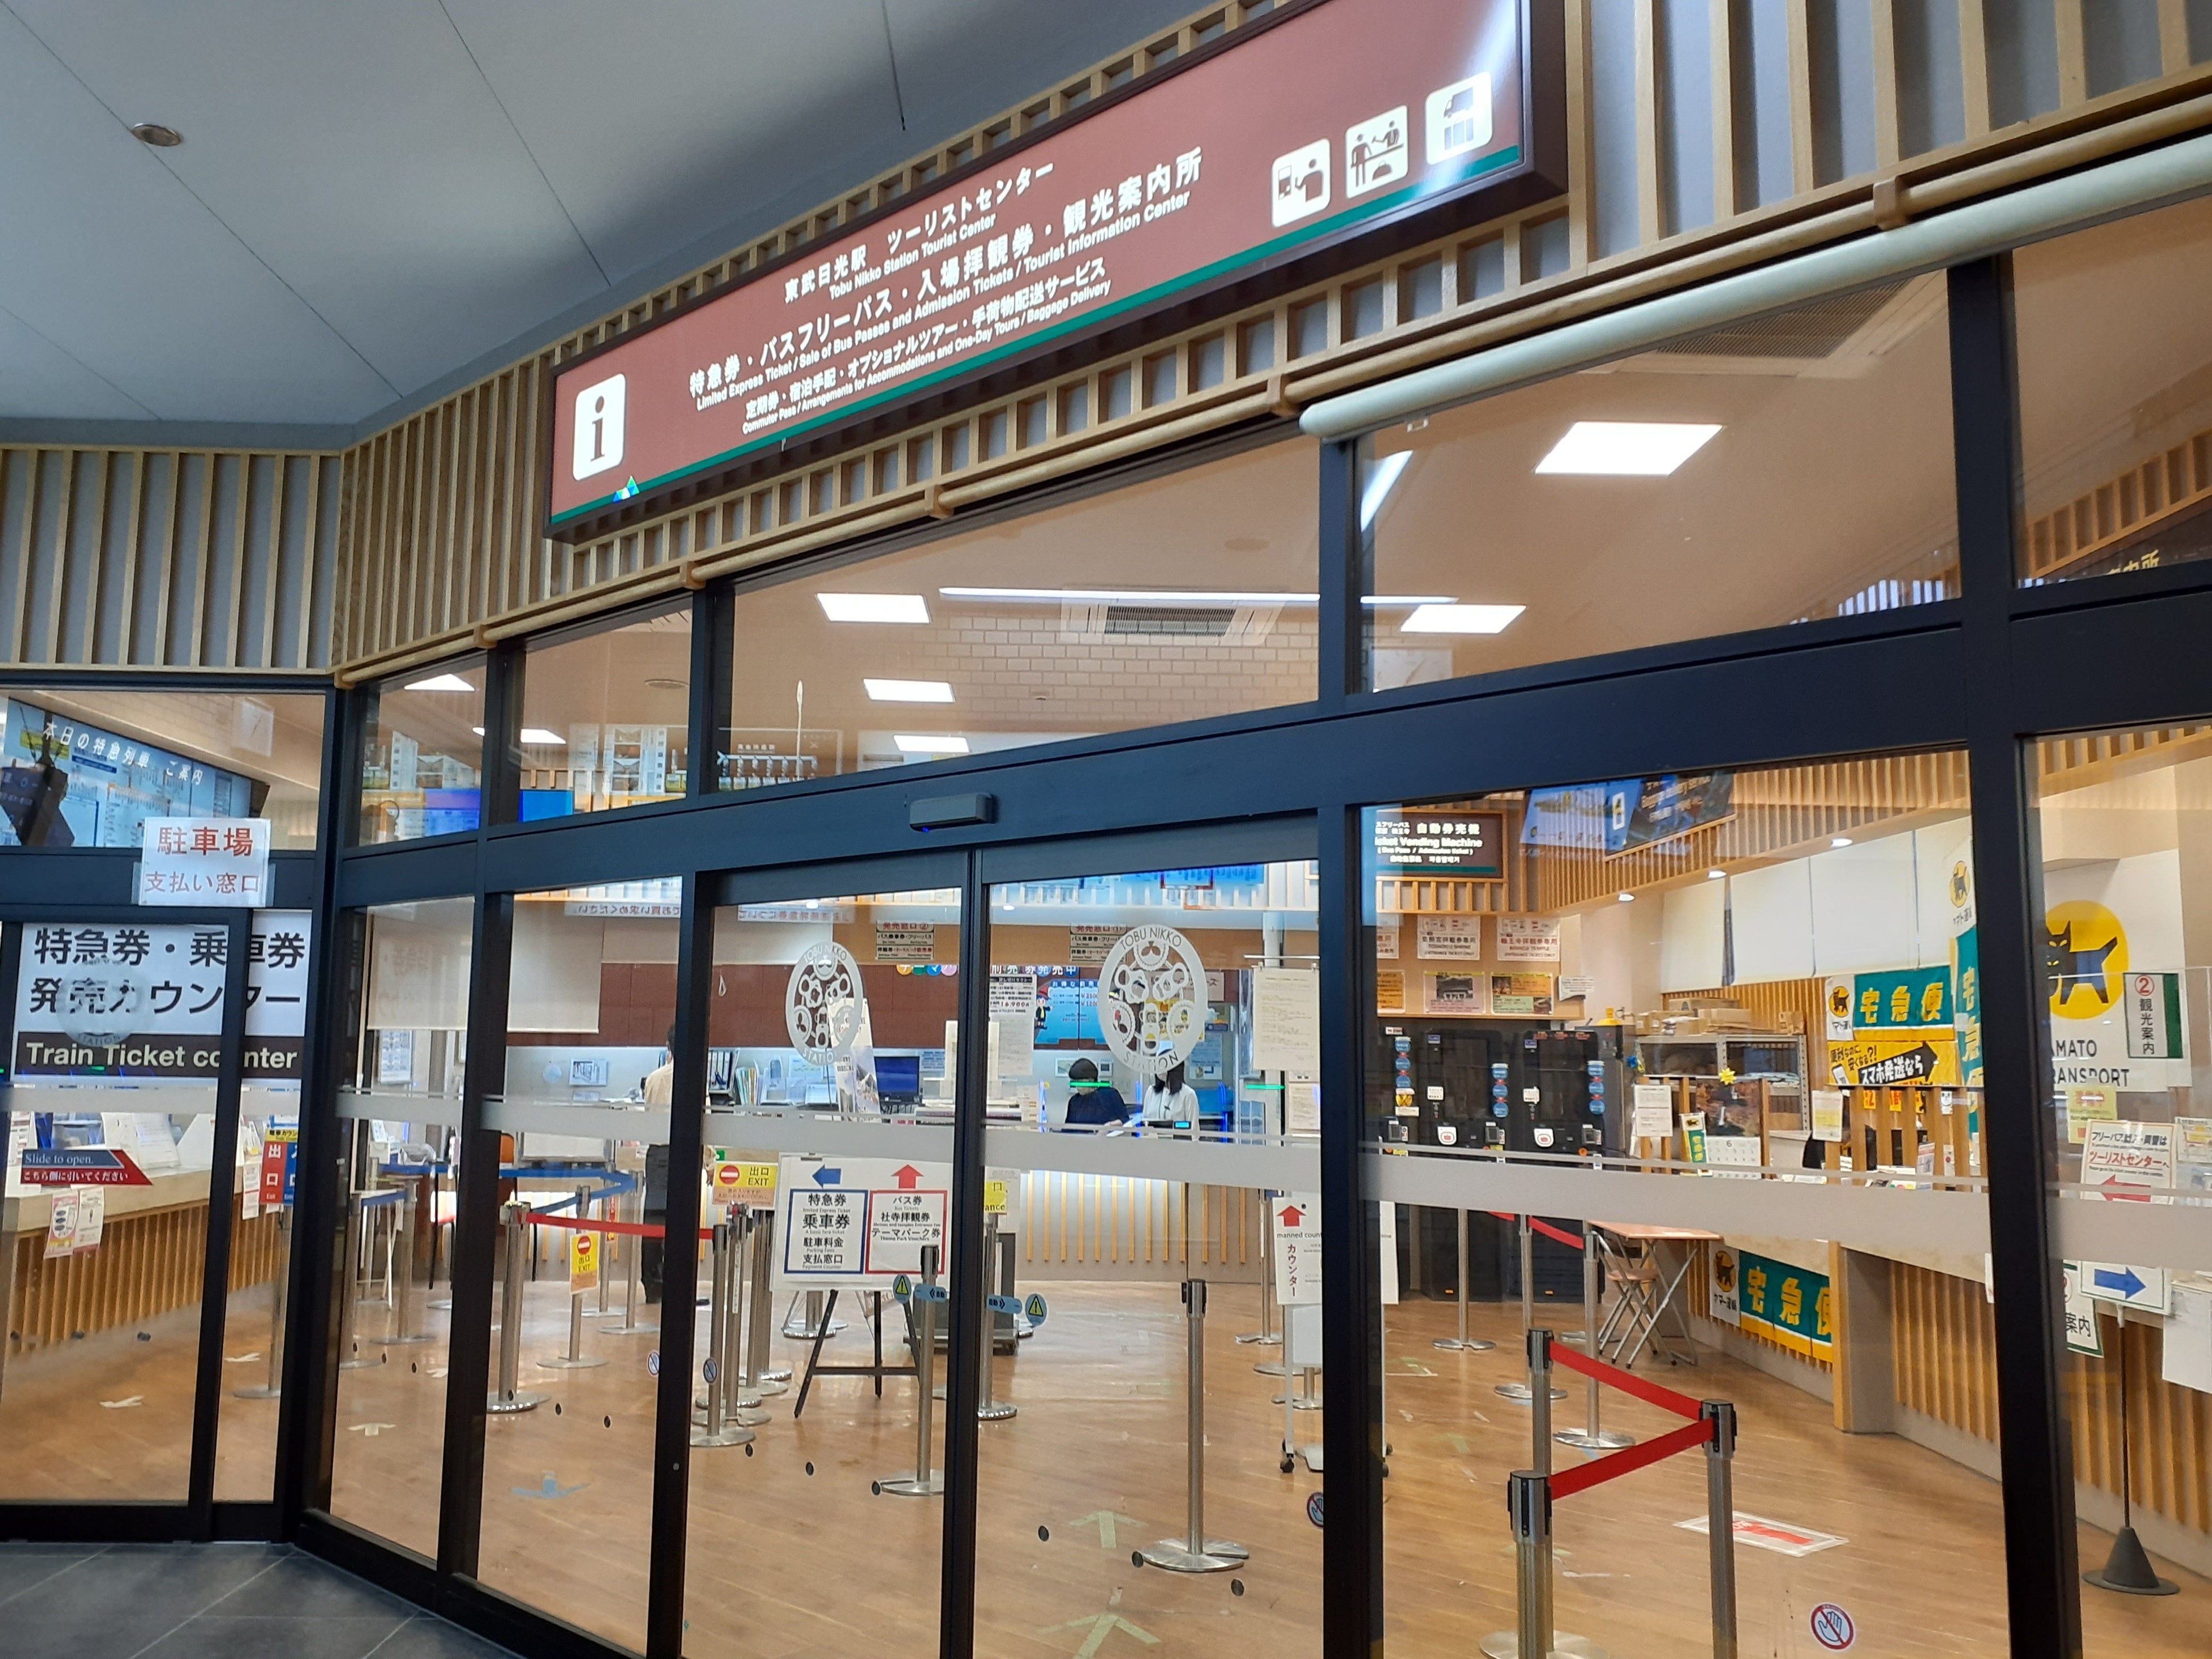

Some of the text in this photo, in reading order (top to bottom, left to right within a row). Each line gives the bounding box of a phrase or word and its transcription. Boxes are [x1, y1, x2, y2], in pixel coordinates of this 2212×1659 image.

[784, 162, 1054, 304] 東武日光駅 ツーリストセンター
[829, 213, 997, 300] Tobu Nikko Station Tourist Center
[696, 387, 727, 411] Limited
[729, 374, 763, 397] Express
[765, 360, 792, 382] Ticket
[799, 349, 820, 368] Sale
[822, 342, 832, 360] of
[833, 336, 852, 354] Bus
[855, 320, 890, 345] Passes
[892, 308, 912, 330] and
[914, 285, 970, 321] Admission
[973, 267, 1014, 296] Tickets
[1023, 243, 1065, 274] Tourist
[1067, 212, 1141, 256] Information
[1143, 191, 1191, 222] Center
[742, 413, 778, 435] Commuter
[779, 404, 796, 421] Pass
[801, 383, 853, 412] Arrangements
[854, 377, 866, 391] for
[867, 351, 936, 387] Accommodations
[937, 341, 953, 360] and
[955, 328, 993, 352] One-Day
[994, 316, 1020, 336] Tours
[1027, 298, 1069, 324] Baggage
[1070, 280, 1111, 307] Delivery
[157, 826, 254, 856] 駐車場
[1399, 837, 1441, 849] Vending
[1441, 838, 1483, 847] Machine
[145, 872, 260, 894] 支払い窓口
[1120, 927, 1181, 950] TOBU NIKKO
[1860, 982, 1943, 1023] 宅急便
[26, 1042, 298, 1069] Train Ticket conter
[1830, 1045, 1861, 1062] 便利なのに
[1861, 1055, 1923, 1084] スマホ発送なら
[2053, 1067, 2130, 1087] ANSPORT
[1726, 1139, 1733, 1148] 6
[25, 1154, 52, 1164] Slide
[66, 1156, 94, 1167] open.
[266, 1143, 281, 1187] 出口
[2089, 1151, 2169, 1168] ツーリストセンターへ
[24, 1171, 129, 1182] こちら側に引いてください
[750, 1166, 769, 1176] 出口
[748, 1177, 769, 1186] EXIT
[808, 1193, 846, 1206] 特急券
[893, 1195, 922, 1206] バス券
[802, 1214, 850, 1229] 乗車券
[880, 1211, 931, 1222] 社寺拝観券
[872, 1227, 941, 1238] テーマパーク券
[803, 1237, 844, 1248] 駐車料金
[803, 1253, 843, 1264] 支払窓口
[1287, 1243, 1298, 1297] カウンター
